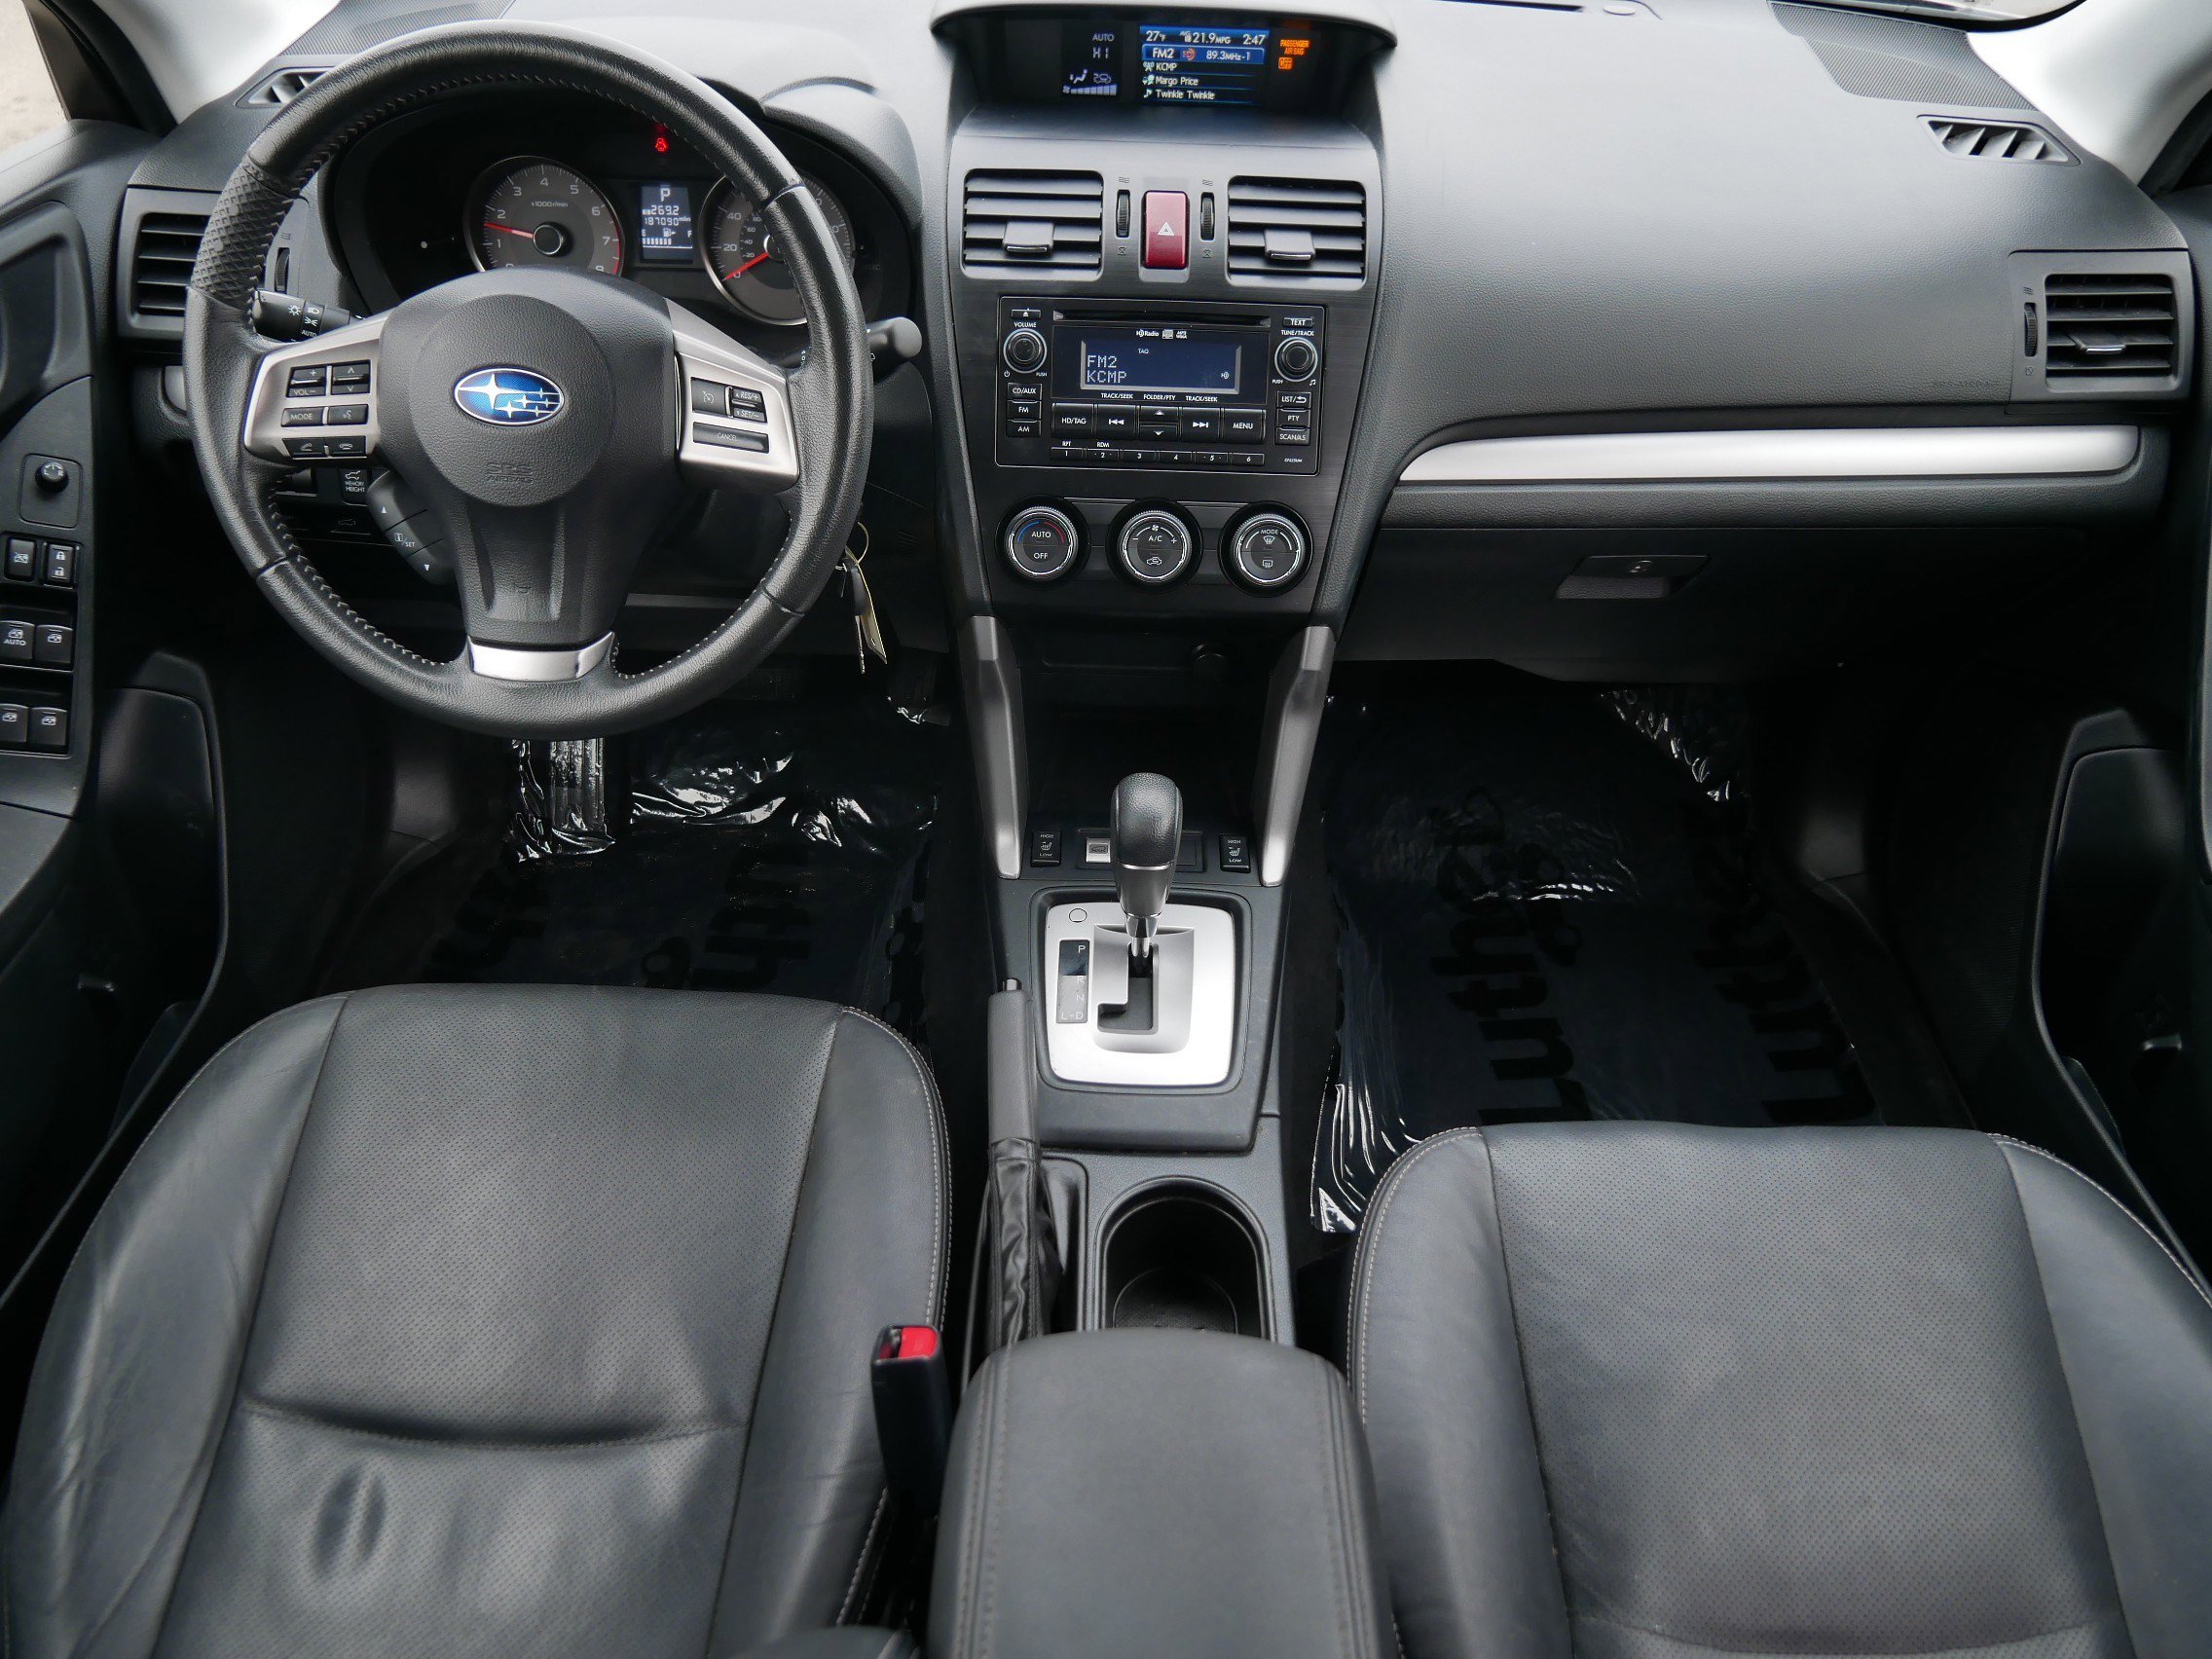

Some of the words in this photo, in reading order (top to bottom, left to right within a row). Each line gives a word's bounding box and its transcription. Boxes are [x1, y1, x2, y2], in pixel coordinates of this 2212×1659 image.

[1092, 33, 1115, 42] AUTO
[1242, 34, 1266, 45] 2:47
[1280, 39, 1309, 48] PASSENGER
[1152, 48, 1175, 58] FM2
[1156, 62, 1177, 71] KCMP
[1278, 57, 1292, 69] OFF
[1156, 76, 1178, 86] Margo
[1180, 76, 1198, 86] Price
[1156, 90, 1184, 99] Twinkle
[1187, 90, 1215, 100] Twinkle
[539, 177, 548, 187] 4
[513, 186, 522, 196] 3
[570, 184, 579, 195] 5
[660, 187, 671, 202] P
[498, 209, 506, 219] 2
[591, 206, 601, 216] 6
[727, 212, 742, 221] 40
[497, 239, 501, 248] 1
[602, 236, 611, 245] 7
[722, 243, 737, 252] 20
[302, 329, 318, 338] AUTO
[1087, 355, 1118, 369] FM2
[1087, 371, 1127, 384] KCMP
[1013, 387, 1037, 396] CD/AUX
[717, 432, 738, 441] CANCEL
[487, 462, 533, 475] SRS
[486, 475, 534, 485] AIRBAG
[1077, 976, 1084, 984] R
